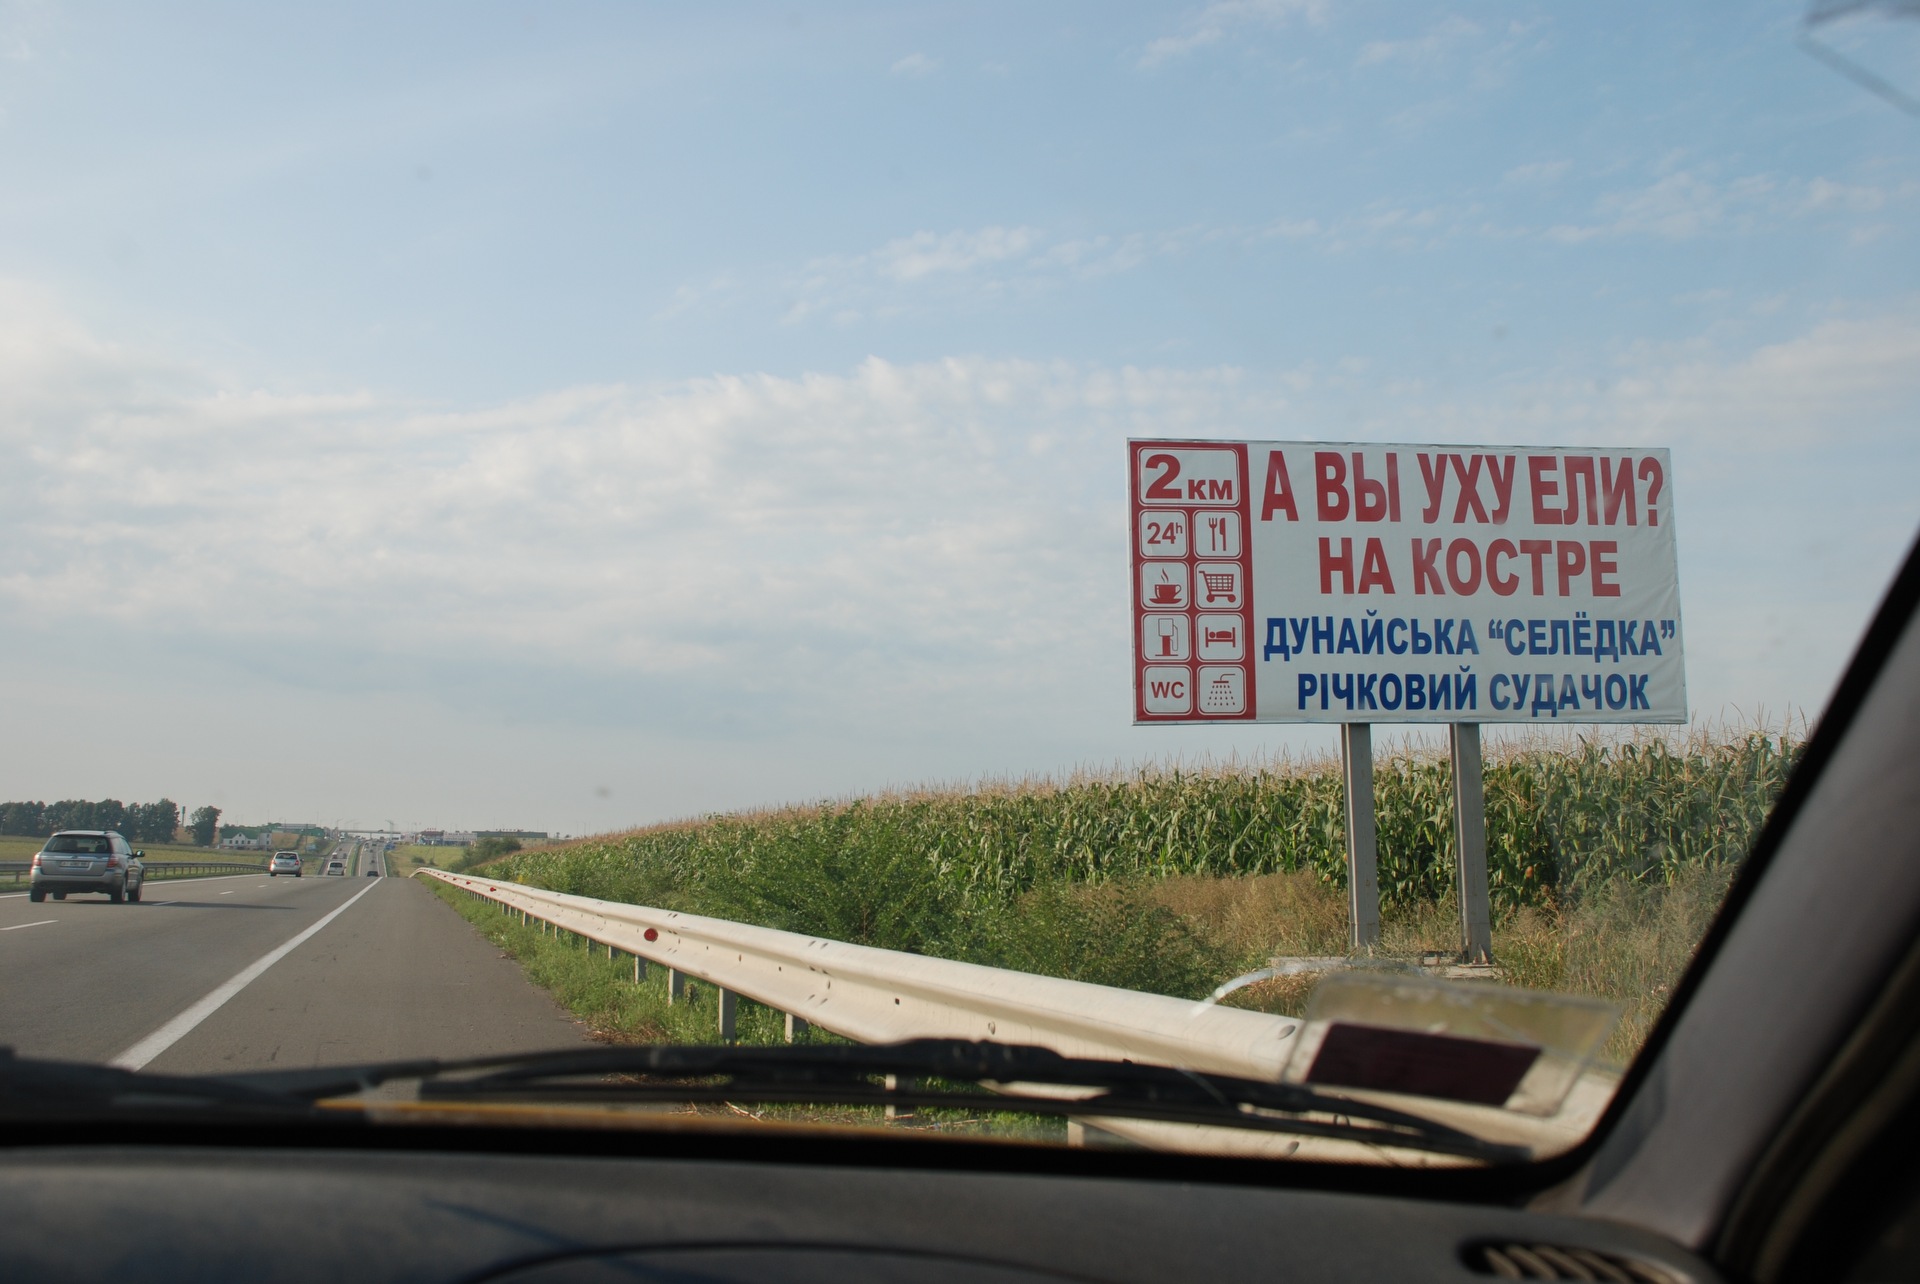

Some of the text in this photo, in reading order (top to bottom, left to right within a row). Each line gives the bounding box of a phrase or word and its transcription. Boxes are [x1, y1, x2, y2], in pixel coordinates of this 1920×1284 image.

[1145, 453, 1182, 499] 2
[1261, 450, 1664, 527] А ВЫ УХУ ЕЛИ?
[1318, 537, 1621, 597] НА КОСТРЕ
[1263, 609, 1480, 662] ДУНАЙСЬКА
[1151, 681, 1185, 699] WC
[1298, 665, 1651, 717] РІЧКОВИЙ СУДАЧОК
